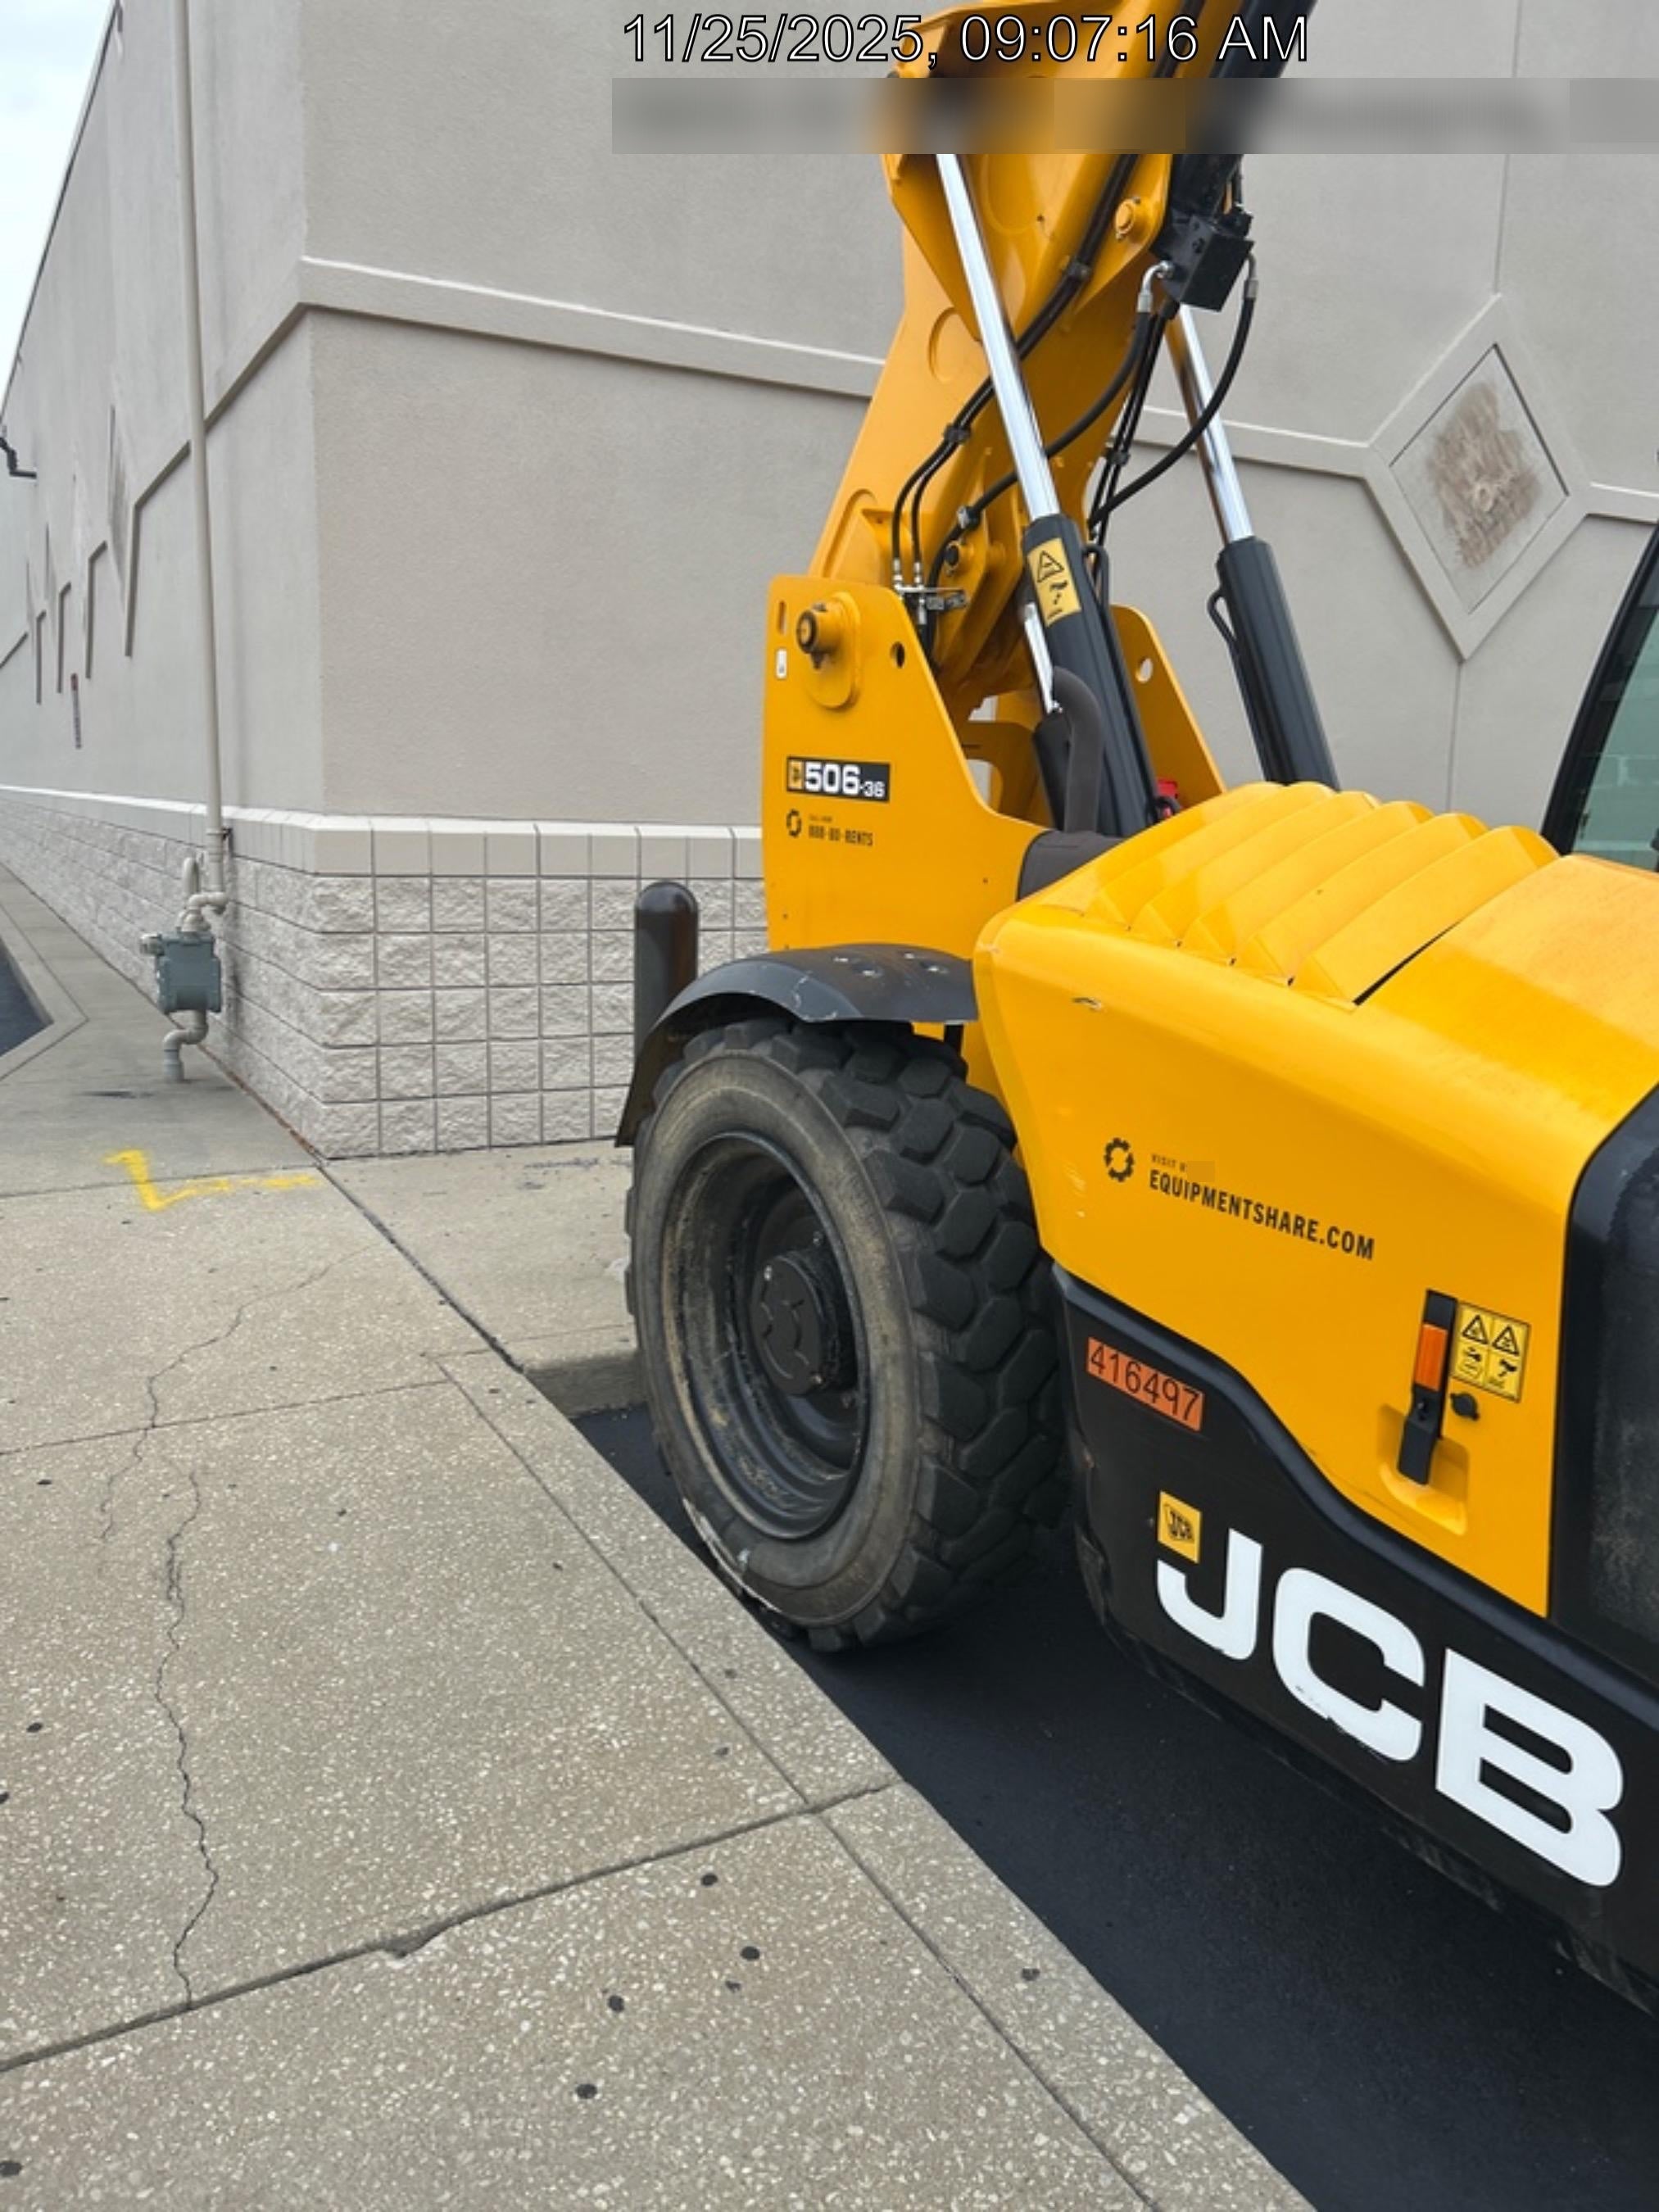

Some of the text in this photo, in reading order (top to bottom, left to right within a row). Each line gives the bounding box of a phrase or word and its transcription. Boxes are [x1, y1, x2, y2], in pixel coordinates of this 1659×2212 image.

[1149, 1169, 1375, 1261] EQUIPMENTSHARE.COM
[1090, 1344, 1199, 1421] 416497
[1157, 1528, 1624, 1887] JCB
